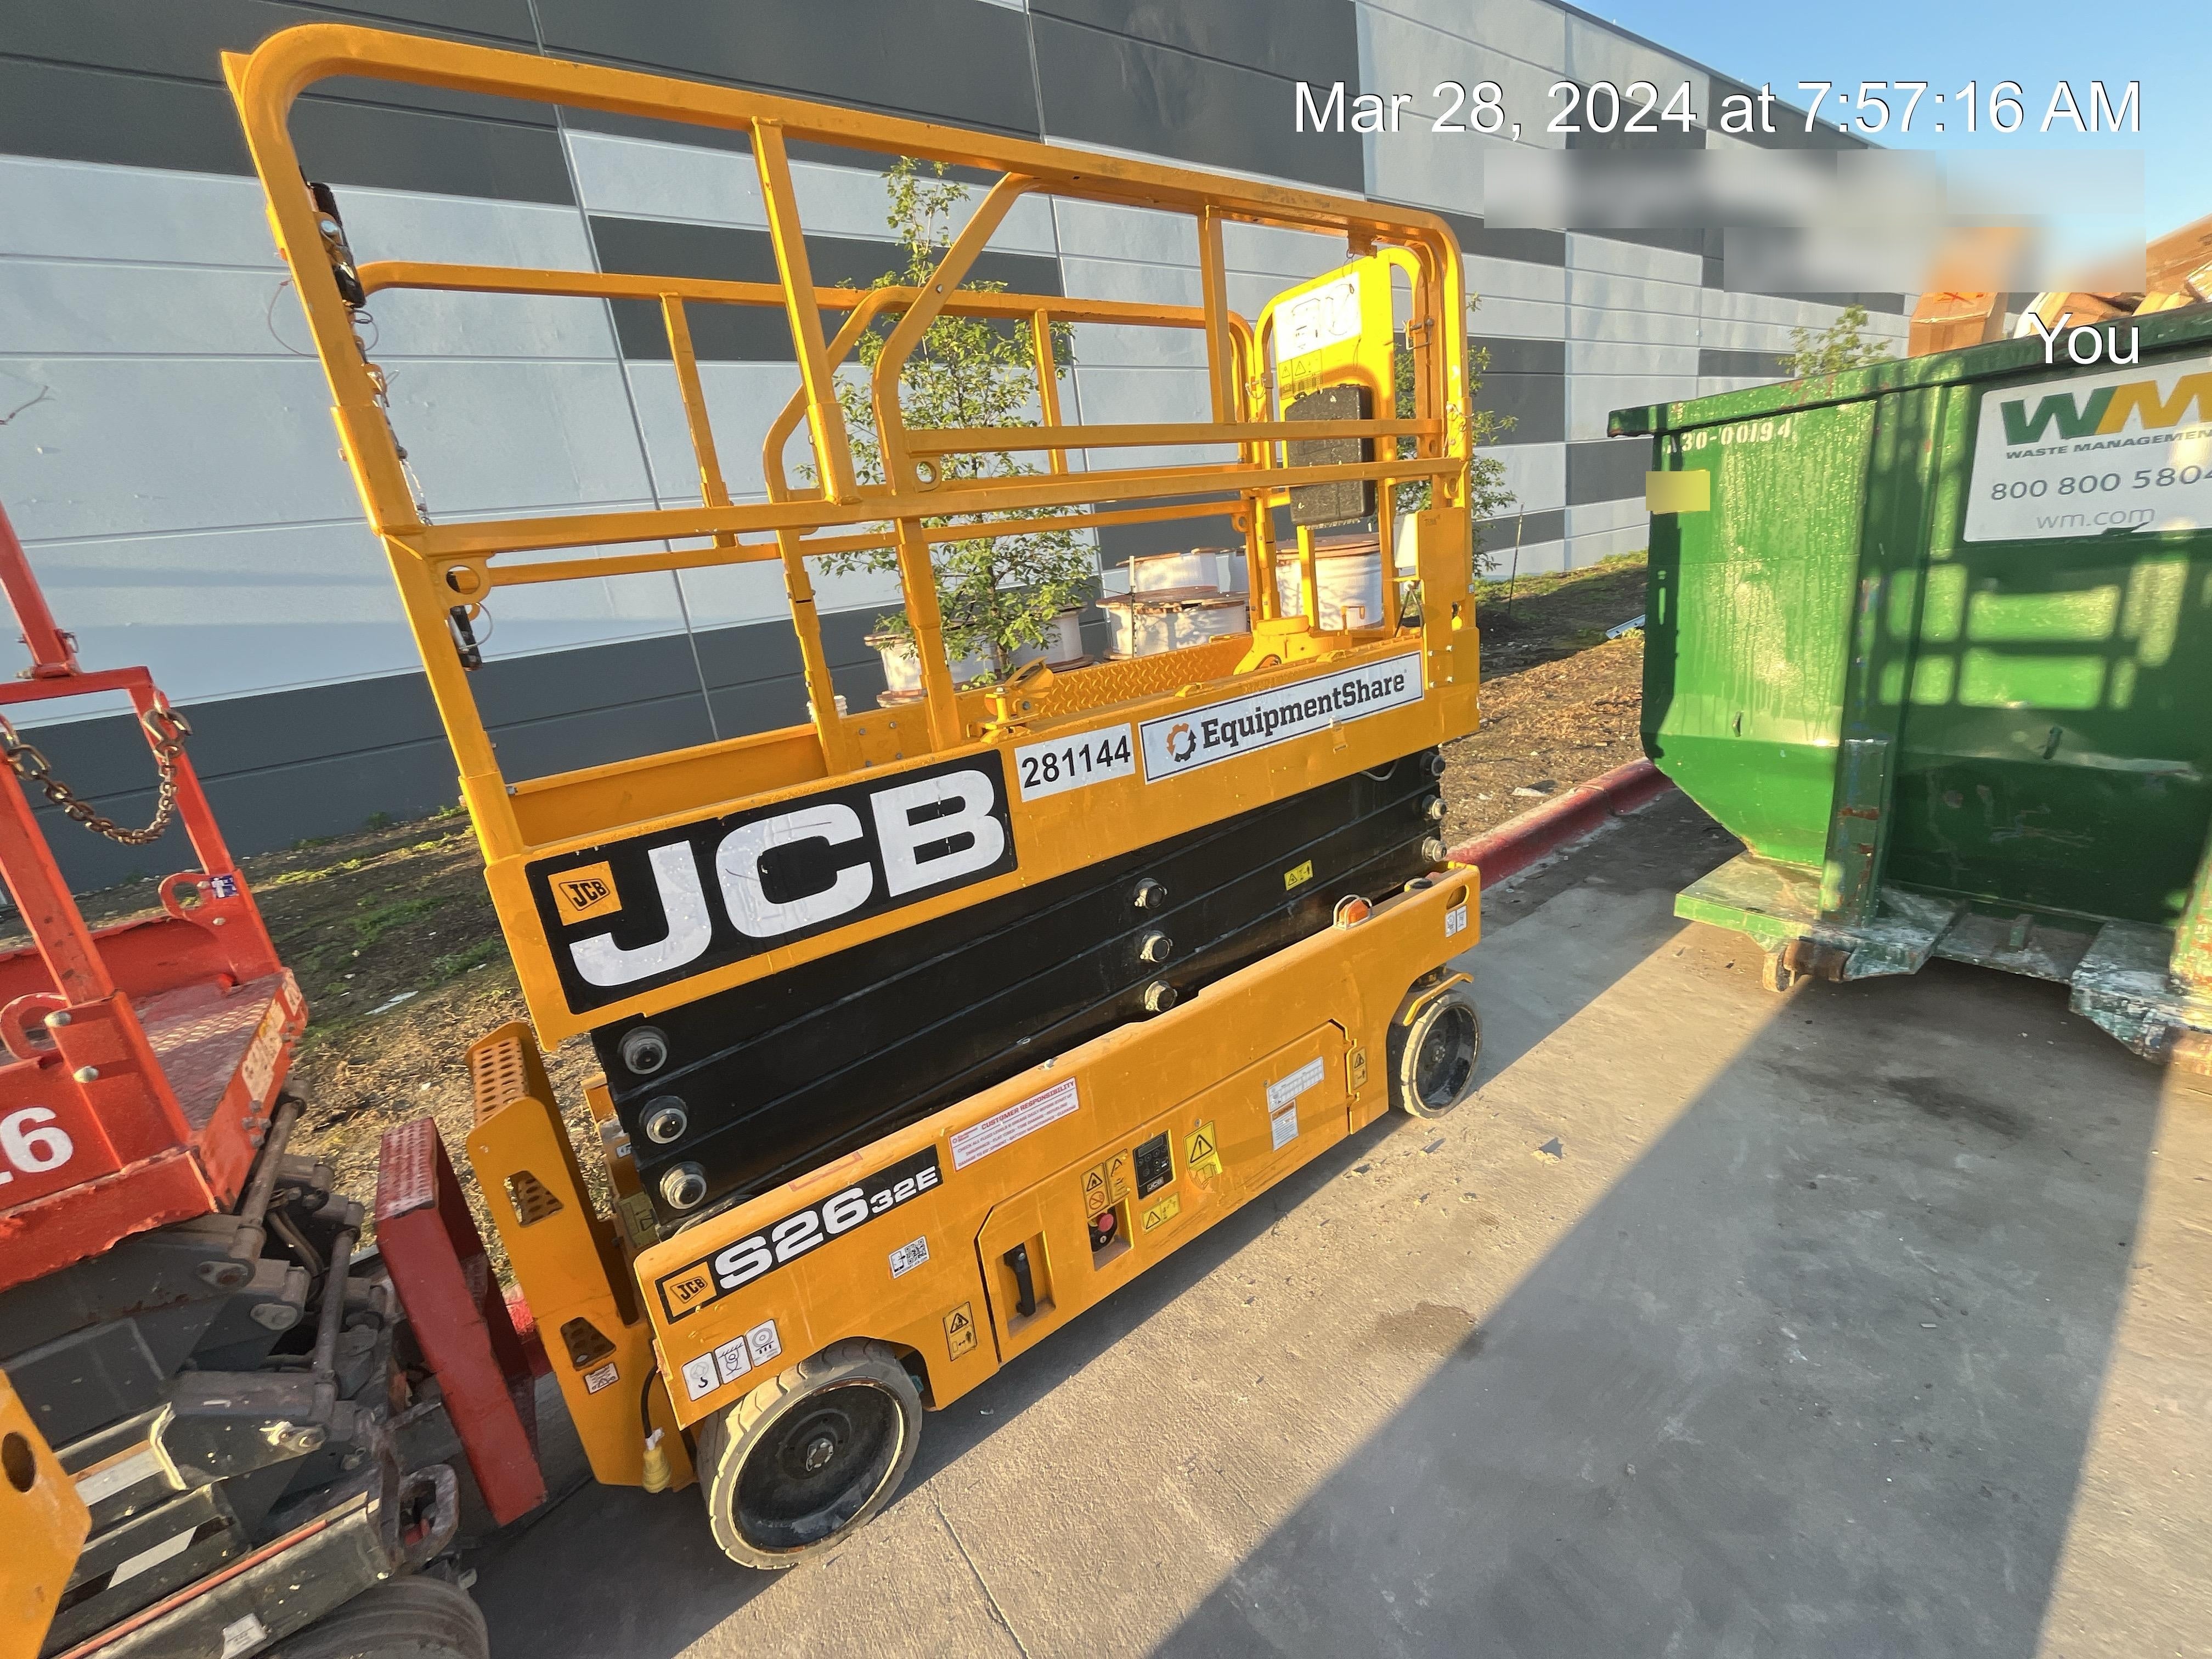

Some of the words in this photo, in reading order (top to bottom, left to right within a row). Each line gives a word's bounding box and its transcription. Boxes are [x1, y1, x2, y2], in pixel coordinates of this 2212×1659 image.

[2000, 371, 2212, 446] WM
[2006, 445, 2069, 460] WASTE
[1991, 479, 2047, 501] 800
[2057, 472, 2121, 496] 800
[2036, 507, 2155, 530] wm.com
[1201, 672, 1406, 749] EquipmentShare
[1021, 734, 1131, 788] 281144
[569, 769, 1006, 987] JCB
[569, 878, 607, 906] JCB
[981, 1107, 1019, 1130] CUSTOMER
[1019, 1080, 1074, 1111] RESPONSIBILITY
[676, 1278, 706, 1301] JCB
